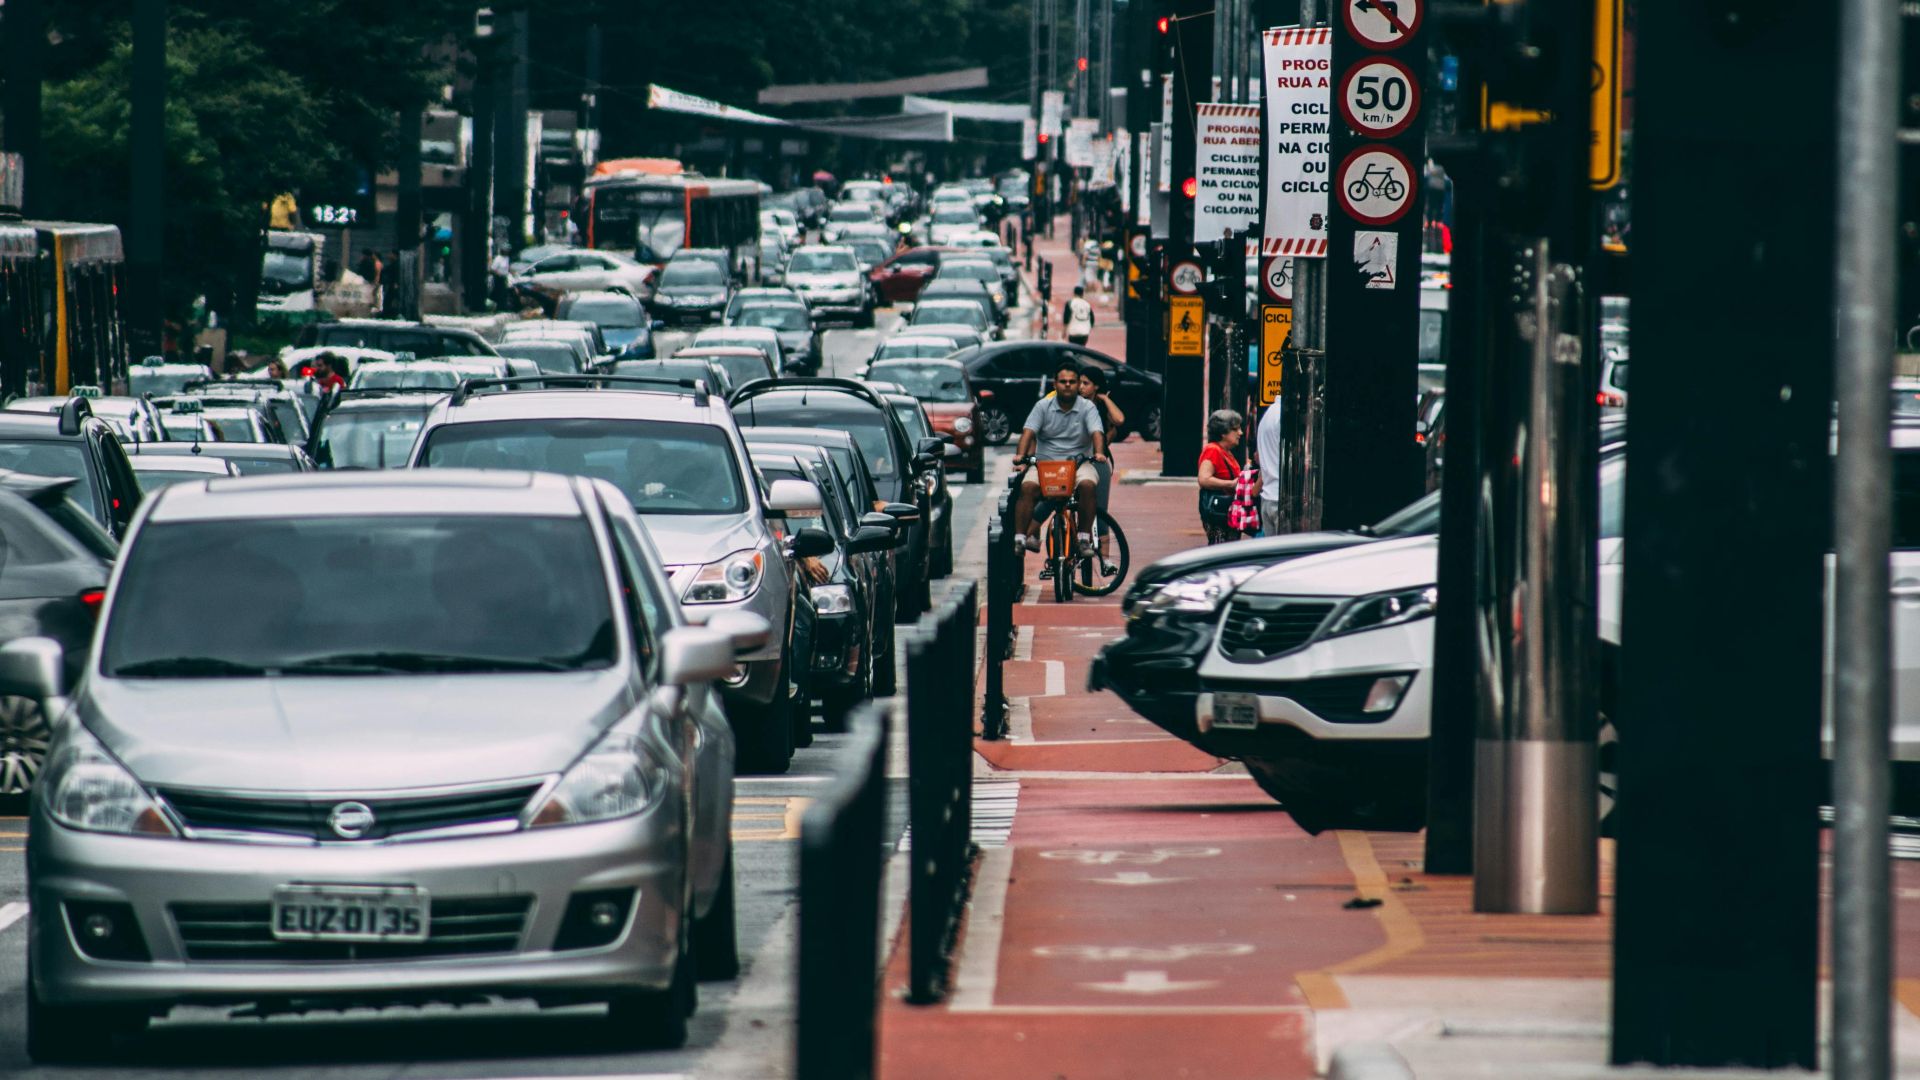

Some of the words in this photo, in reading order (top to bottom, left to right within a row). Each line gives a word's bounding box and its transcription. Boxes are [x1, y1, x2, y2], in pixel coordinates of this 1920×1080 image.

[1282, 59, 1329, 71] PROG
[1278, 76, 1313, 88] RUA
[1317, 76, 1329, 88] A
[1355, 75, 1407, 112] 50
[1291, 102, 1330, 115] CICL
[1362, 112, 1394, 124] km/h
[1203, 136, 1226, 145] RUA
[1278, 142, 1302, 154] NA
[1302, 161, 1326, 174] OU
[1201, 179, 1218, 188] NA
[1218, 192, 1235, 201] OU
[1239, 193, 1253, 202] NA
[1265, 313, 1291, 323] CICL
[74, 387, 98, 397] TAXI
